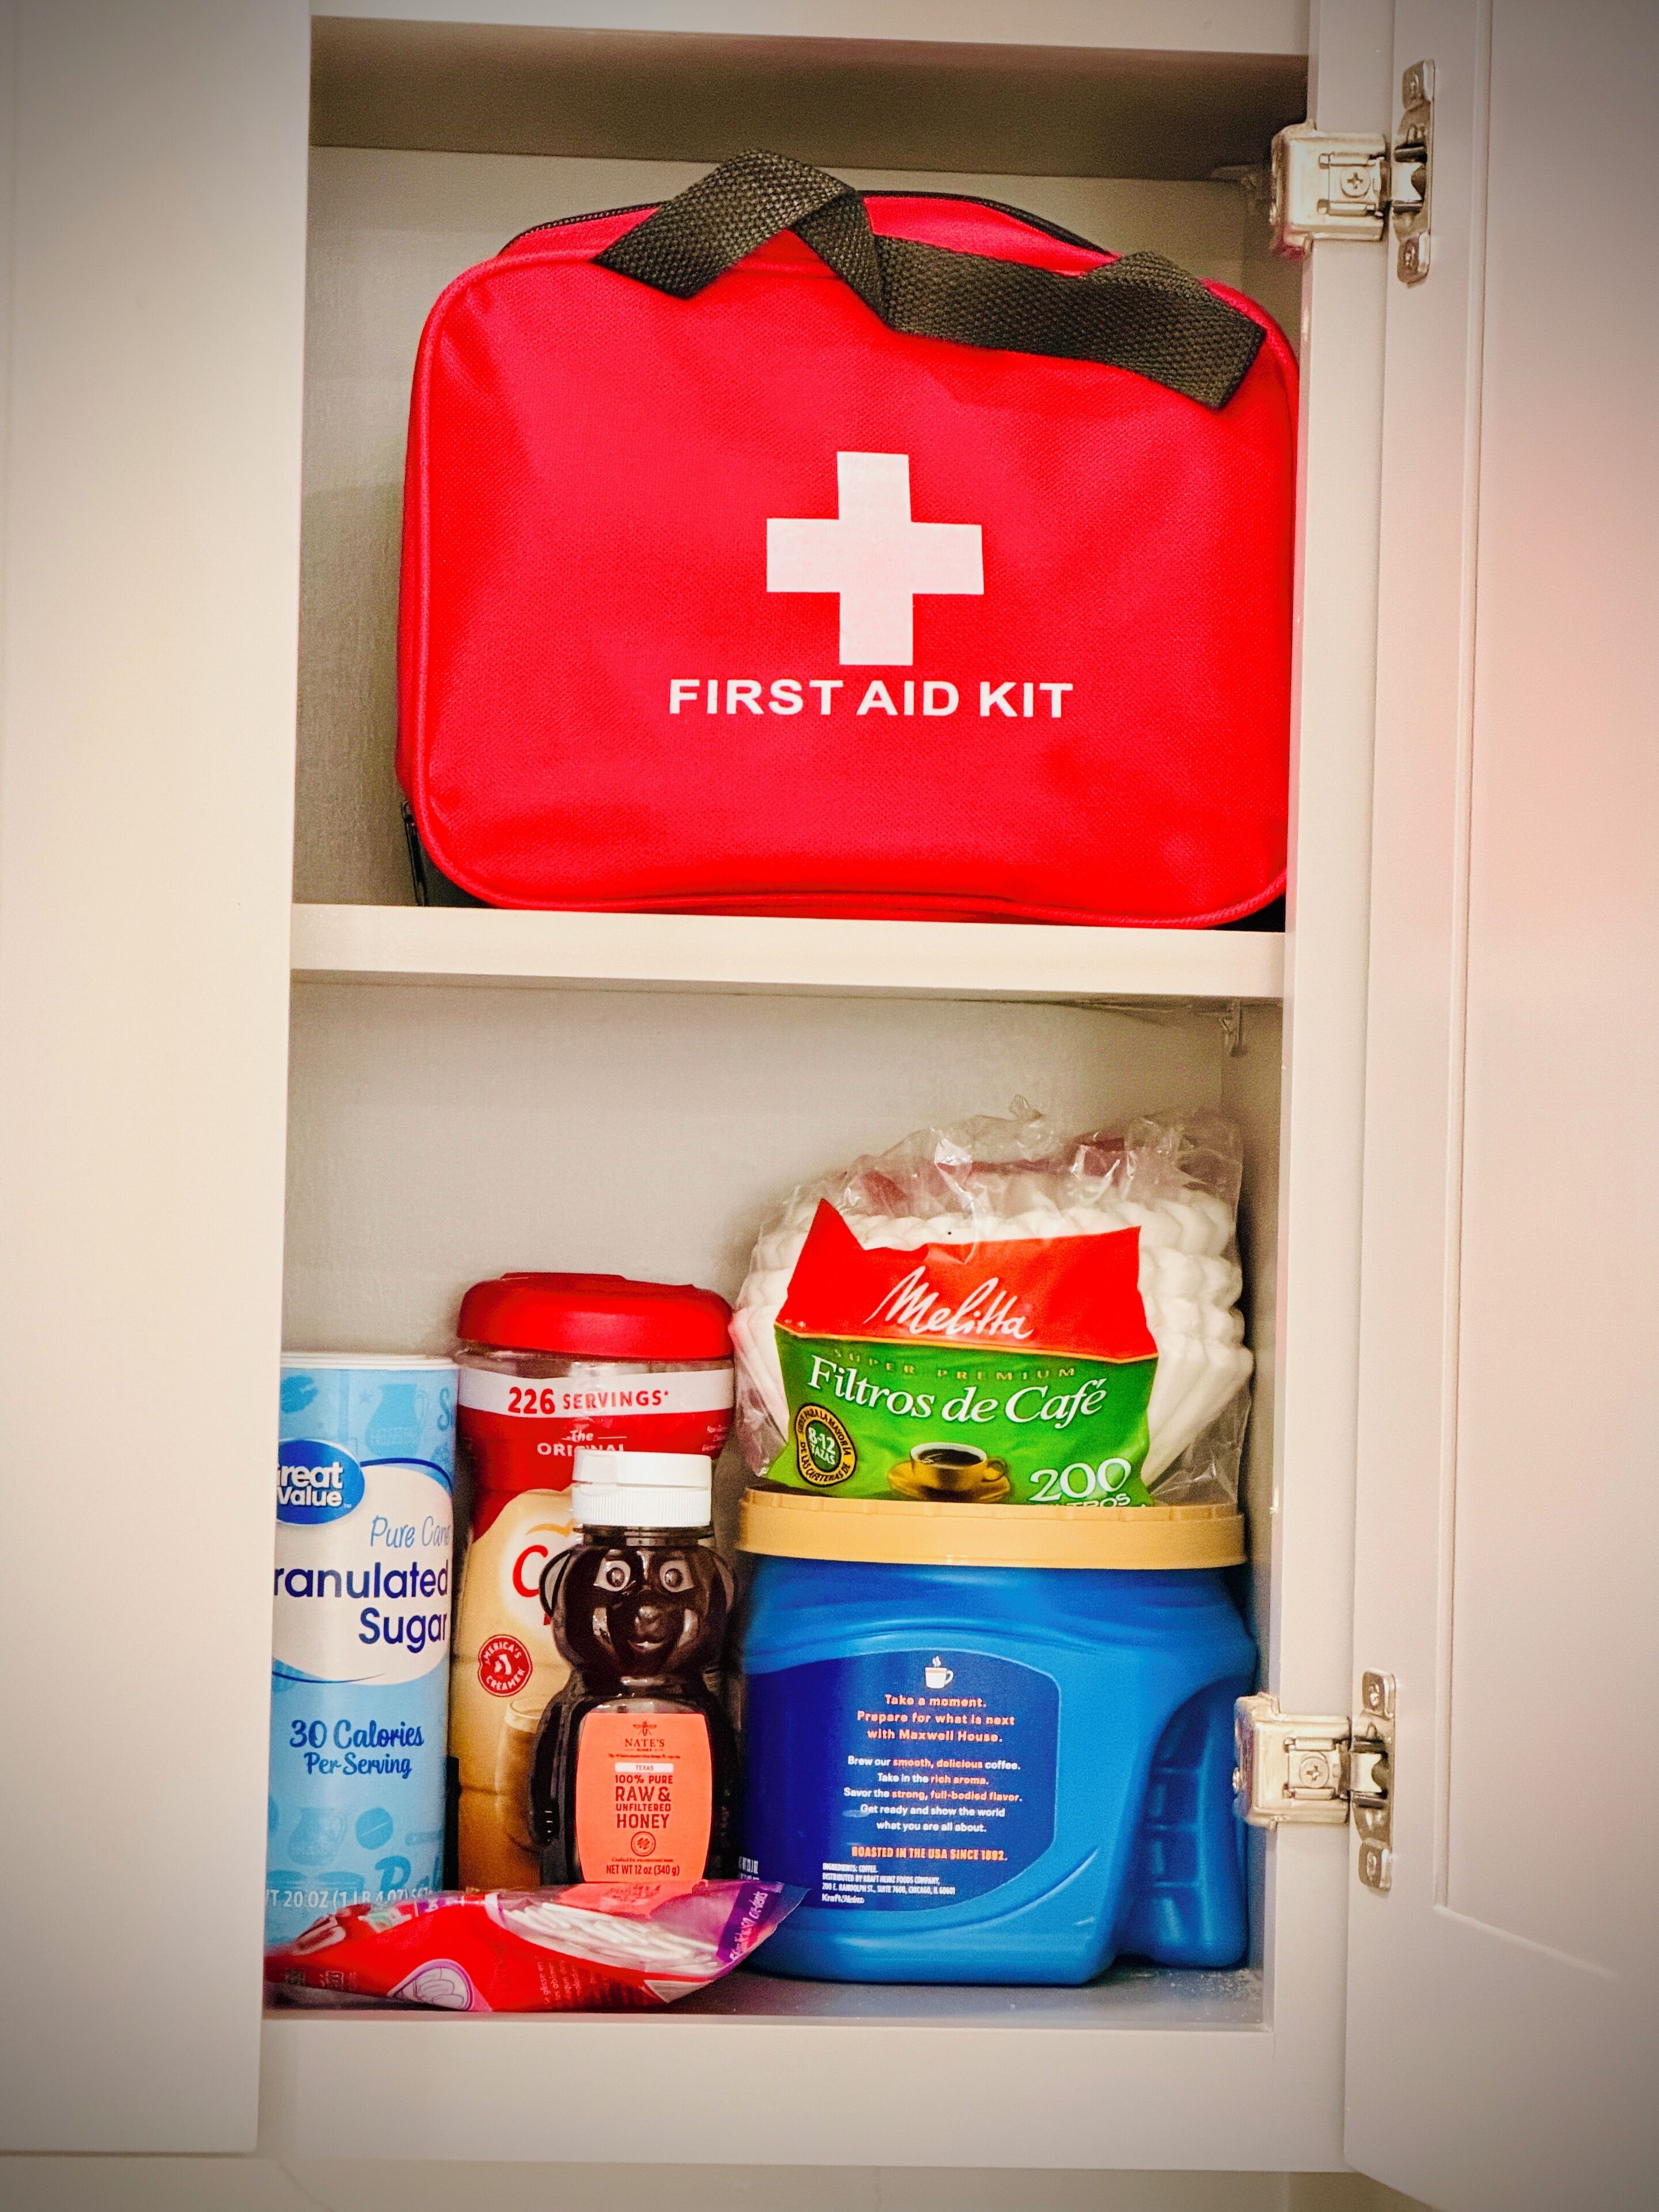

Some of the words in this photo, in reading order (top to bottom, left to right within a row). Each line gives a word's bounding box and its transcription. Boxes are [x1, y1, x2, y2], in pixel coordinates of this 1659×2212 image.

[669, 679, 843, 715] FIRST
[856, 680, 959, 716] AID
[980, 681, 1073, 718] KIT
[863, 1265, 1034, 1339] Melitta
[834, 1349, 915, 1374] SUPER
[937, 1368, 1075, 1381] PREMIUM
[807, 1354, 935, 1418] Filtros
[942, 1385, 998, 1423] de
[1005, 1378, 1107, 1429] Café
[507, 1387, 556, 1414] 226
[808, 1427, 835, 1455] 8-12
[810, 1444, 835, 1465] TAZAS
[1028, 1458, 1131, 1501] 200
[276, 1486, 342, 1507] Value
[370, 1516, 415, 1548] Pure
[274, 1559, 448, 1598] ranulated
[358, 1607, 447, 1653] Sugar
[486, 1667, 525, 1691] CREAMER
[885, 1694, 914, 1705] Take
[918, 1698, 925, 1706] a
[929, 1698, 987, 1707] moment.
[857, 1710, 908, 1724] Prepare
[912, 1712, 931, 1723] for
[935, 1713, 967, 1724] what
[971, 1714, 982, 1725] is
[986, 1716, 1014, 1725] next
[289, 1719, 327, 1748] 30
[334, 1719, 424, 1749] Calories
[867, 1729, 895, 1739] with
[899, 1729, 953, 1740] Maxwell
[957, 1730, 1002, 1742] House.
[625, 1738, 665, 1748] NATE'S
[304, 1752, 341, 1775] Per
[342, 1752, 411, 1779] Serving
[848, 1755, 873, 1766] Brew
[893, 1758, 934, 1768] smooth,
[937, 1759, 983, 1768] delicious
[985, 1760, 1021, 1770] coffee.
[615, 1775, 645, 1784] 100%
[649, 1775, 673, 1784] PURE
[877, 1772, 899, 1782] Take
[902, 1773, 910, 1782] in
[912, 1774, 929, 1783] the
[930, 1775, 951, 1783] rich
[953, 1776, 988, 1785] aroma.
[615, 1786, 655, 1802] RAW
[658, 1786, 671, 1802] &
[843, 1787, 872, 1797] Savor
[873, 1789, 889, 1797] the
[892, 1790, 928, 1801] strong,
[930, 1790, 987, 1800] full-bodied
[989, 1791, 1022, 1802] flavor.
[616, 1804, 671, 1812] UNFILTERED
[861, 1804, 878, 1813] Get
[880, 1805, 908, 1816] ready
[910, 1806, 929, 1815] and
[930, 1806, 956, 1816] show
[959, 1806, 975, 1816] the
[978, 1808, 1005, 1817] world
[617, 1813, 669, 1828] HONEY
[876, 1821, 901, 1830] what
[903, 1823, 921, 1832] you
[923, 1823, 939, 1831] are
[941, 1821, 953, 1831] all
[955, 1823, 987, 1832] about.
[851, 1846, 893, 1857] ROASTED
[896, 1847, 906, 1858] IN
[909, 1848, 925, 1858] THE
[928, 1849, 947, 1859] USA
[950, 1849, 979, 1859] SINCE
[606, 1865, 619, 1874] NET
[622, 1865, 632, 1874] WT
[635, 1865, 642, 1874] 12
[643, 1866, 652, 1874] oz
[654, 1865, 670, 1876] (340
[672, 1865, 680, 1876] g)
[823, 1862, 857, 1872] INGREDIENTS:
[823, 1872, 854, 1881] DISTRIBUTED
[896, 1876, 914, 1884] FOODS
[877, 1885, 891, 1893] SUITE
[283, 1891, 304, 1908] 20
[307, 1891, 329, 1908] OZ
